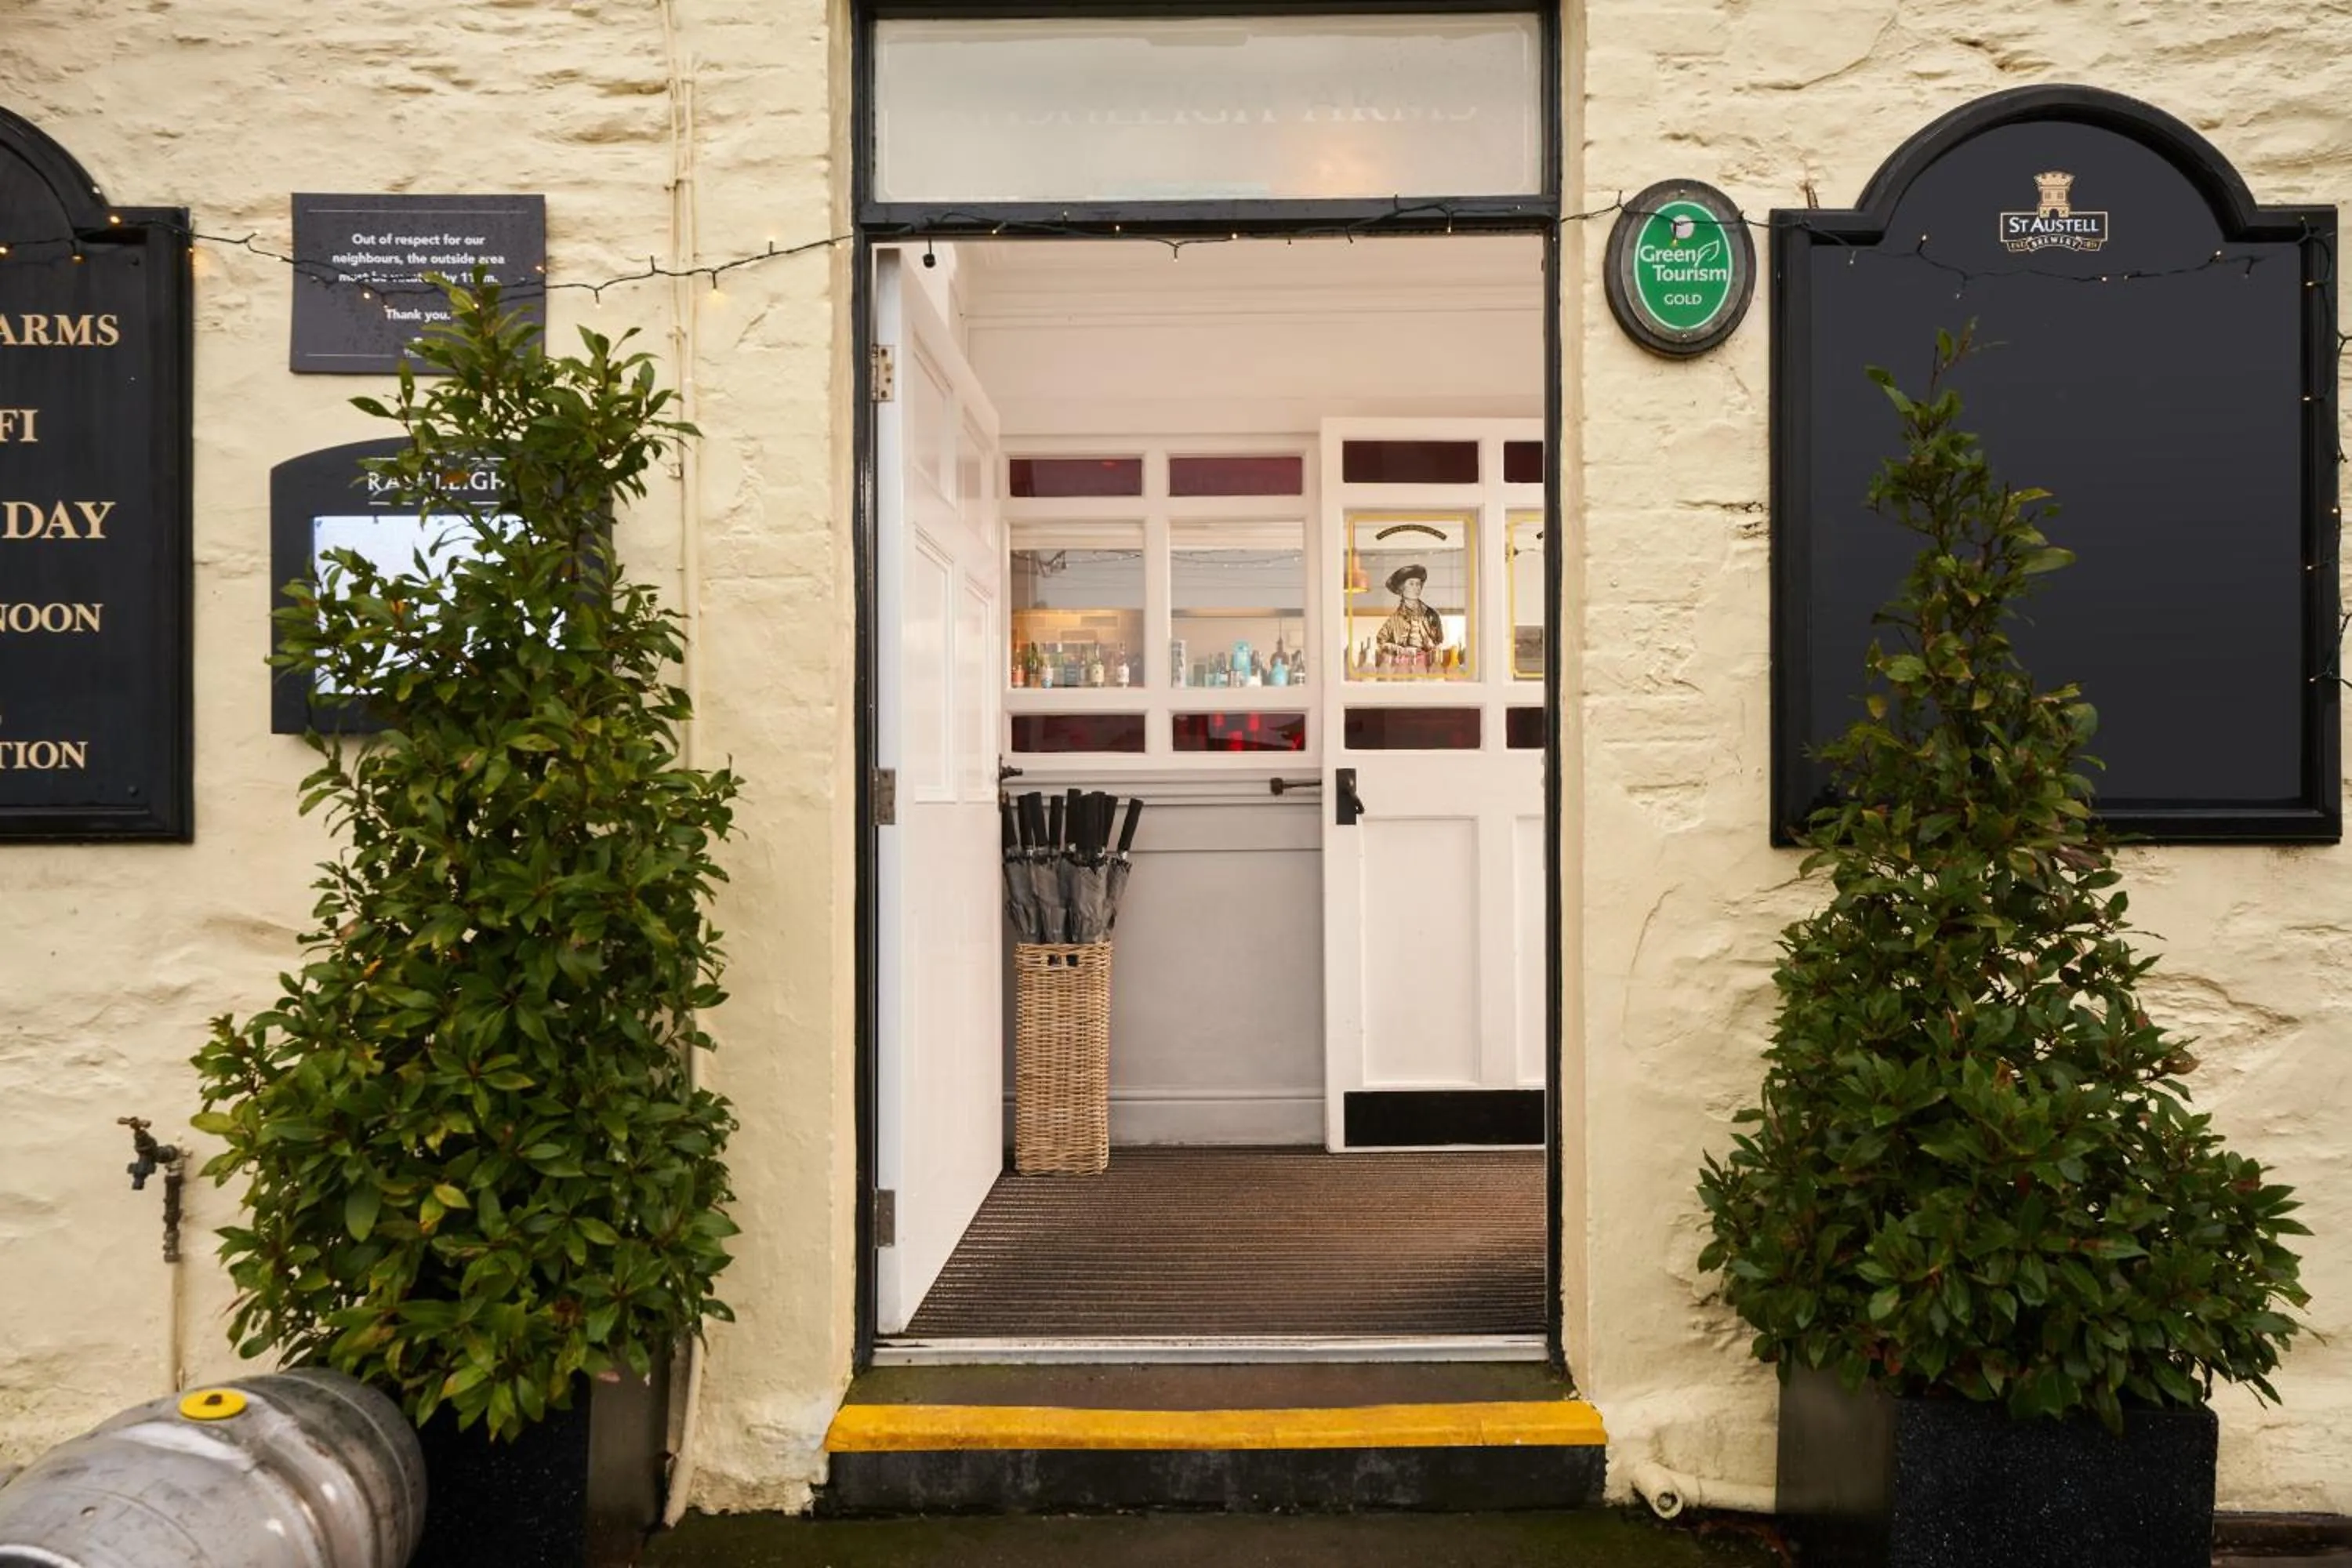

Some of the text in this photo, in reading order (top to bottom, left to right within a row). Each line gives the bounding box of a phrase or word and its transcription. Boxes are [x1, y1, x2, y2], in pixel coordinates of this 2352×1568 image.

[352, 233, 485, 247] Out of respect for our
[332, 252, 505, 265] neighbours, the outside area
[1639, 244, 1696, 263] Green
[460, 271, 499, 283] 11m.
[1652, 264, 1727, 281] Tourism
[1664, 293, 1702, 305] GOLD
[386, 308, 451, 323] Thank you.
[2, 499, 117, 539] DAY
